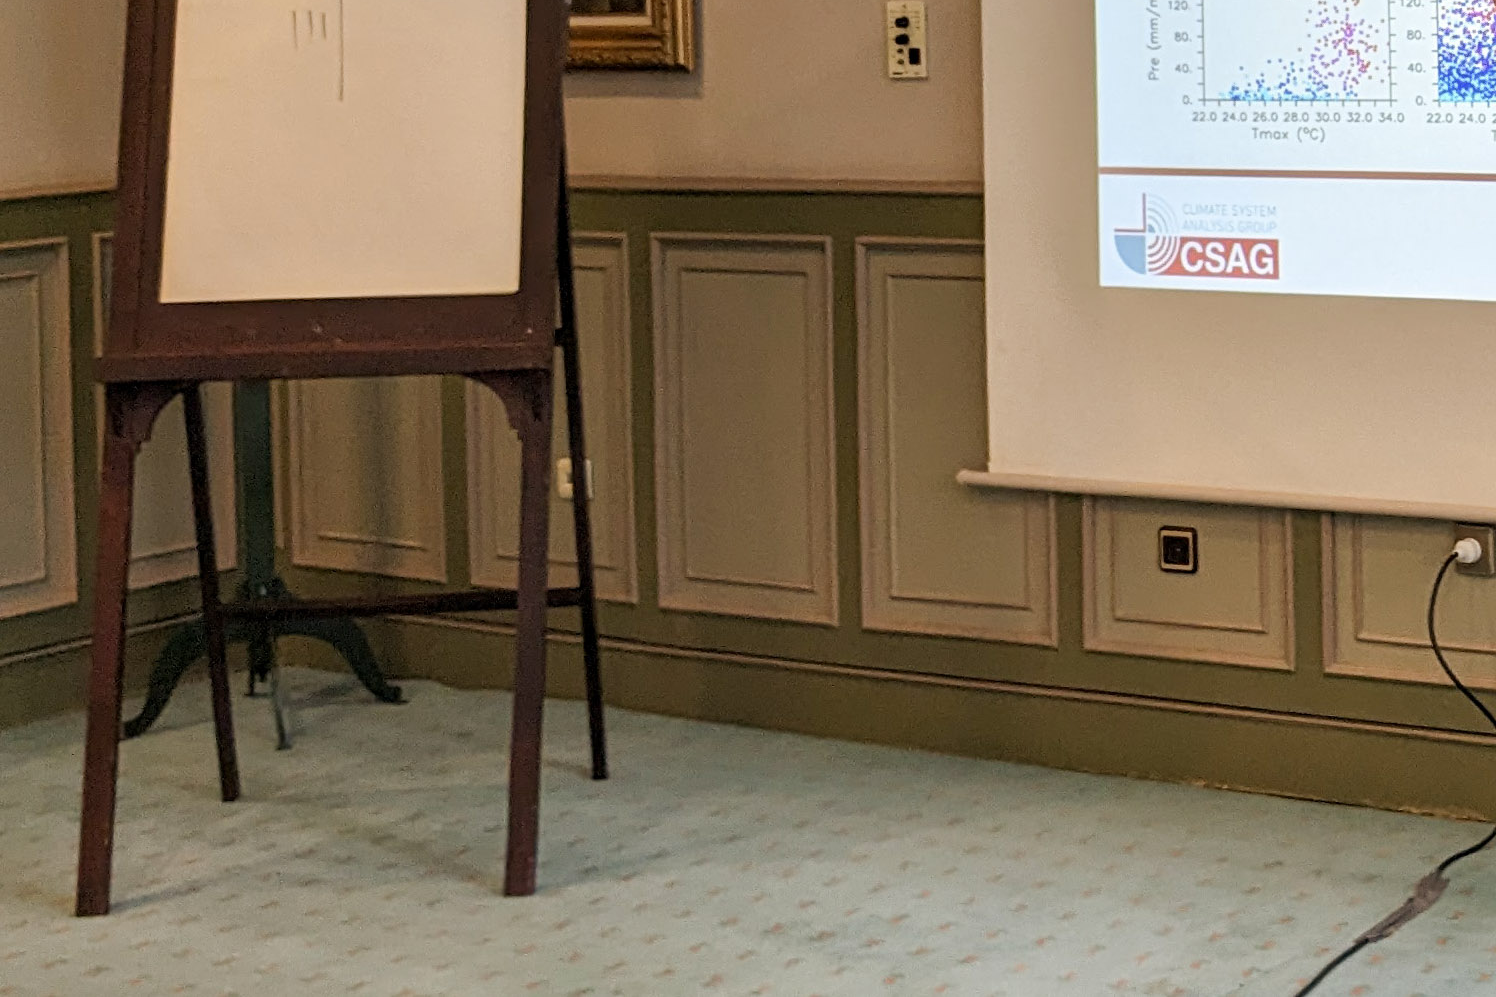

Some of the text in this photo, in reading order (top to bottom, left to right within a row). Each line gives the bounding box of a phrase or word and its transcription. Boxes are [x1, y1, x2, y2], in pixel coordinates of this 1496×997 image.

[1168, 1, 1191, 11] 120.
[1174, 32, 1192, 42] 80.
[1407, 30, 1425, 40] 80.
[1148, 57, 1160, 80] Pre
[1175, 64, 1193, 74] 40.
[1407, 63, 1425, 73] 40.
[1183, 95, 1192, 105] 0.
[1415, 96, 1427, 106] 0.
[1192, 111, 1404, 123] 22.0 24.0 26.0 28.0 30.0 32.0 34.0
[1426, 113, 1453, 124] 22.0
[1459, 113, 1486, 124] 24.0
[1252, 128, 1289, 140] Tmax
[1182, 203, 1276, 216] CLIMATE SYSTEM
[1181, 220, 1277, 234] ANALYSIS GROUP
[1181, 241, 1274, 275] CSAG
